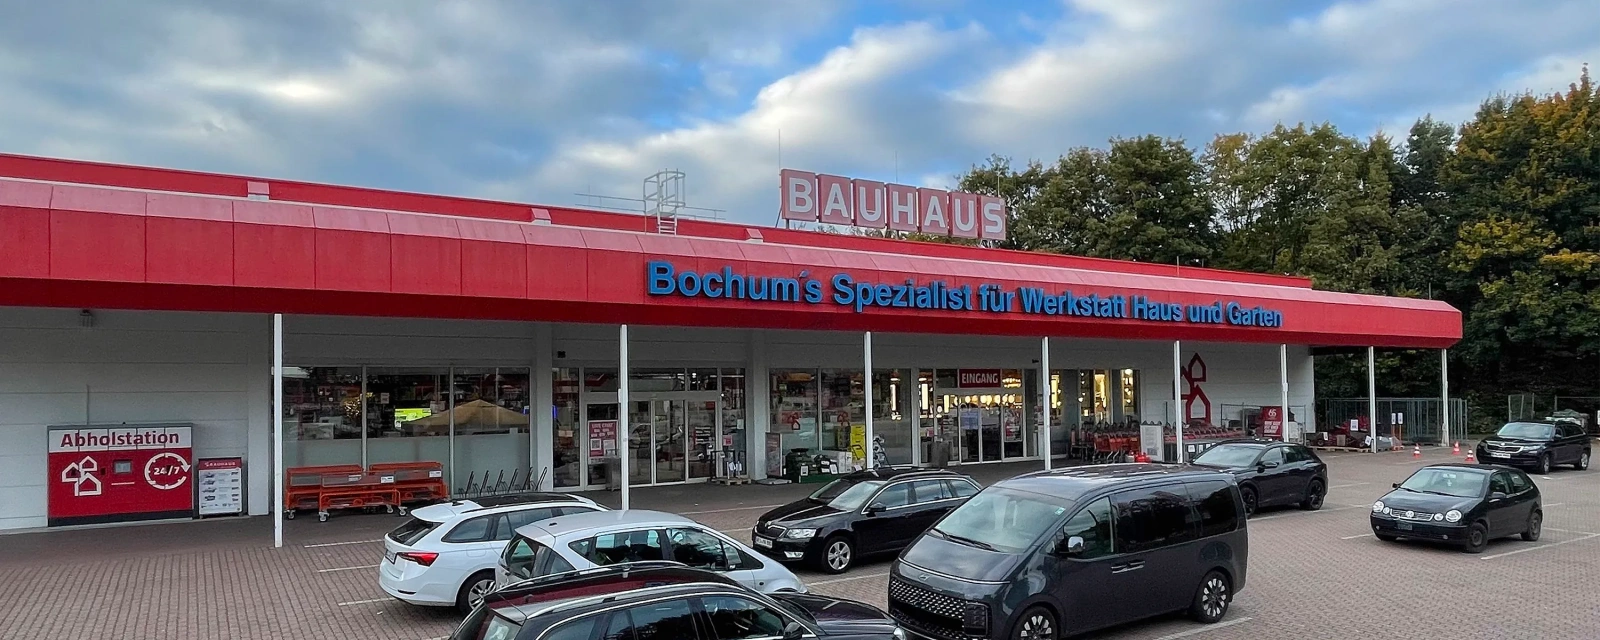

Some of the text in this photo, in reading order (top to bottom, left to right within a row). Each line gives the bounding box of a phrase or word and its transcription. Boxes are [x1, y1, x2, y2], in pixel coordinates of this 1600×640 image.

[789, 177, 1003, 233] BAUHAUS
[831, 273, 972, 313] Spezialist
[977, 283, 1016, 312] für
[1018, 286, 1128, 318] Werkstatt
[1130, 295, 1184, 322] Haus
[1186, 301, 1223, 324] und
[1226, 301, 1283, 327] Garten
[961, 372, 999, 384] EINGANG
[60, 430, 179, 447] Abholstation
[153, 465, 180, 476] 24/7
